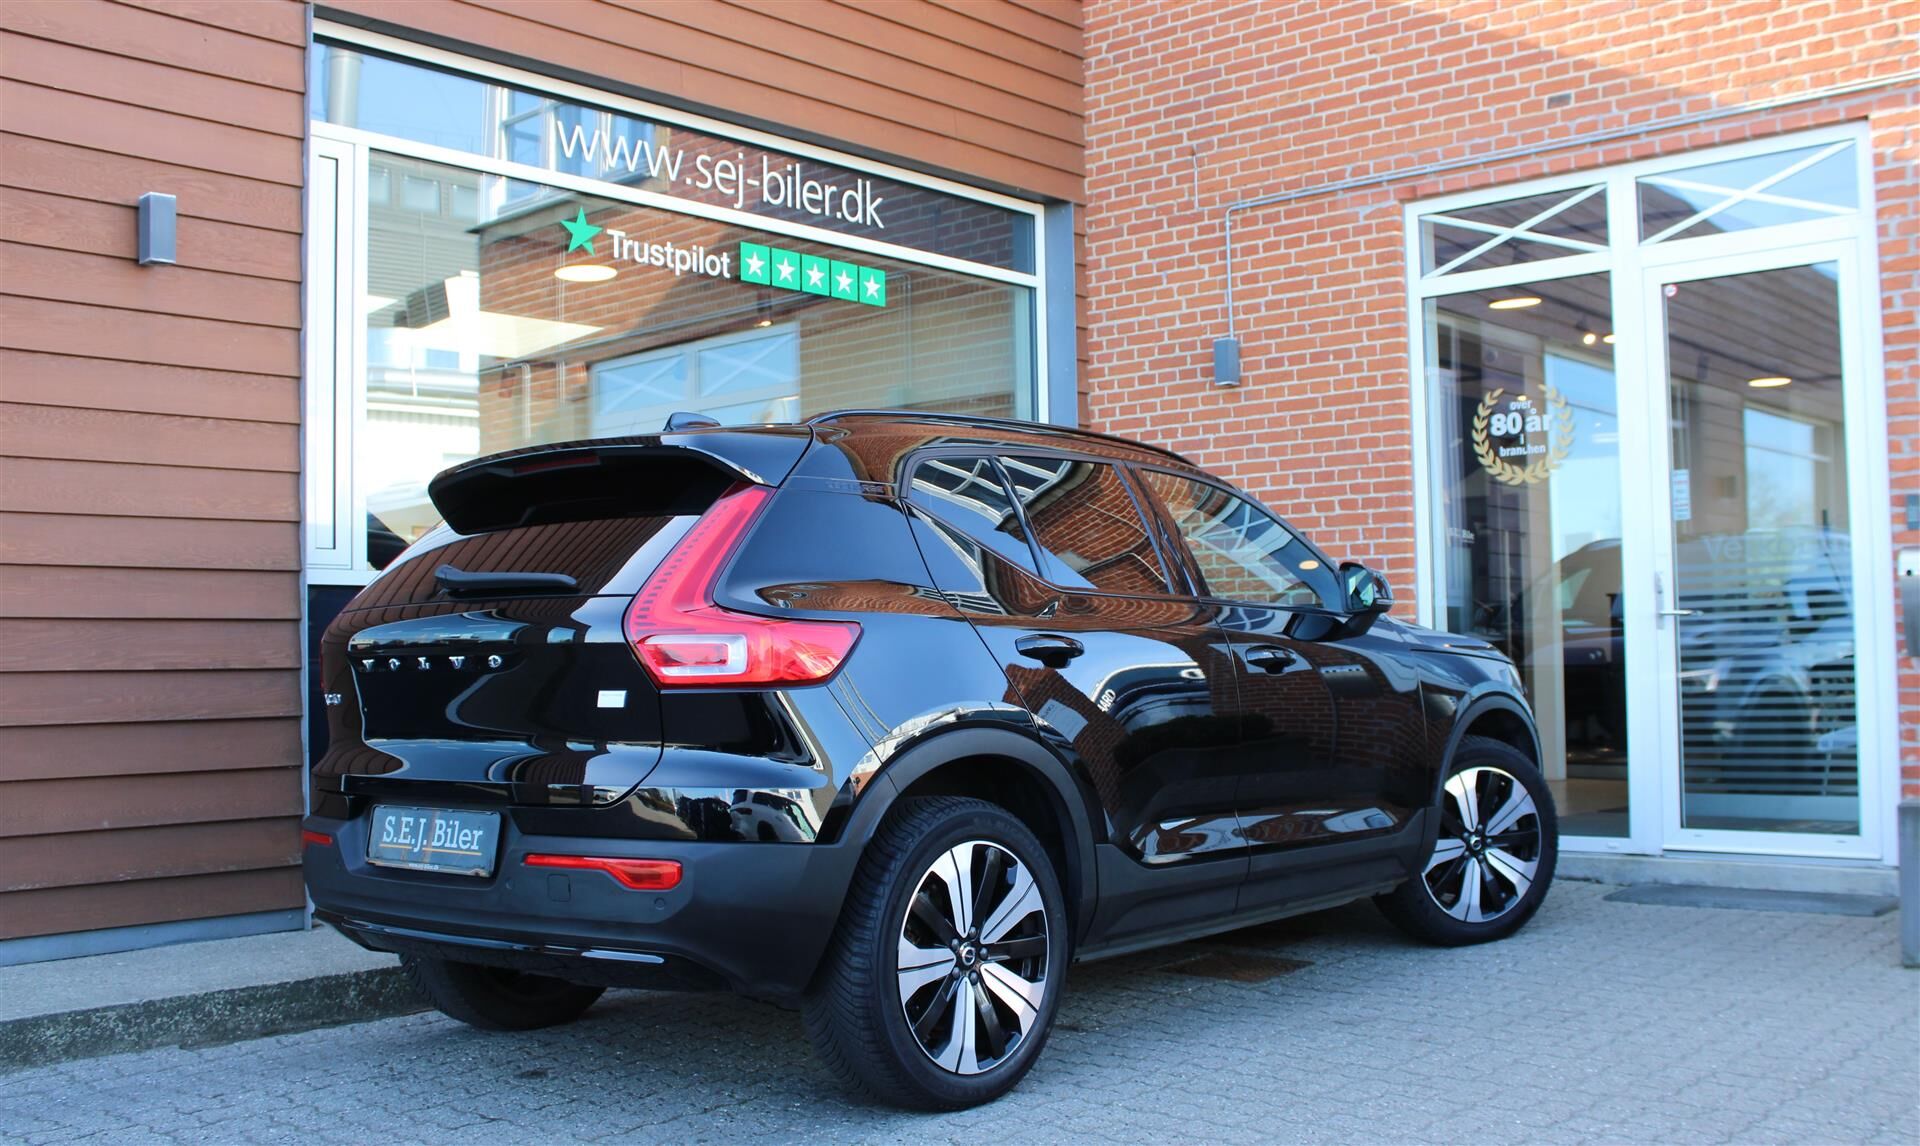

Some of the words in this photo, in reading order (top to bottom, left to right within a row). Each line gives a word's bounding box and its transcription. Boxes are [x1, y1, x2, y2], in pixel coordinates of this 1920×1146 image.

[557, 119, 885, 229] www.sej-biler.dk
[606, 228, 731, 279] Trustpilot
[1489, 412, 1523, 436] 80
[1524, 407, 1552, 433] år
[1509, 400, 1532, 411] over
[362, 655, 502, 671] VOLVO
[383, 816, 428, 852] S.E.J.
[432, 819, 484, 850] Biler
